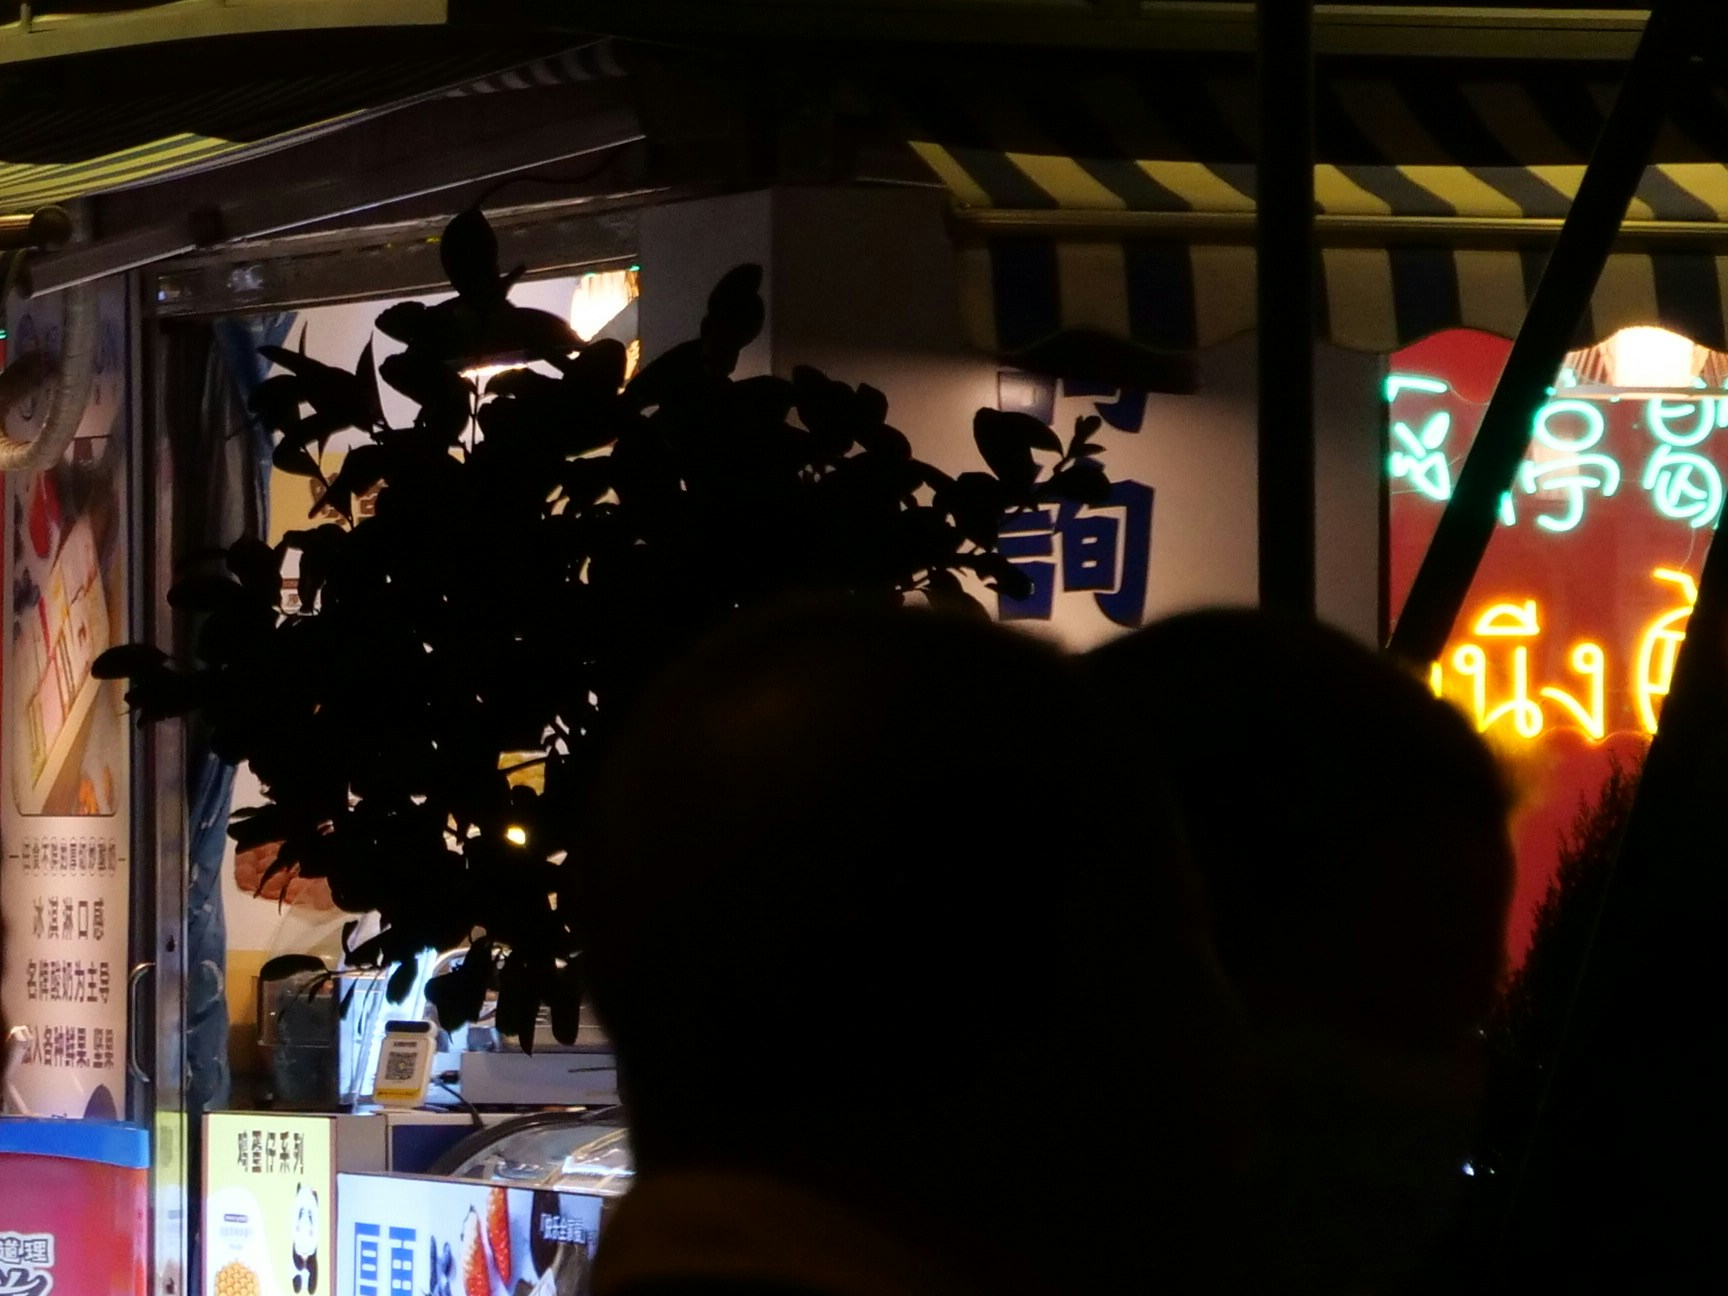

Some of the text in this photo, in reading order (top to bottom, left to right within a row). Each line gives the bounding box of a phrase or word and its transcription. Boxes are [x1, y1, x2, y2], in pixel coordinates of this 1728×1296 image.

[237, 1130, 305, 1174] 鸡蛋仔系列
